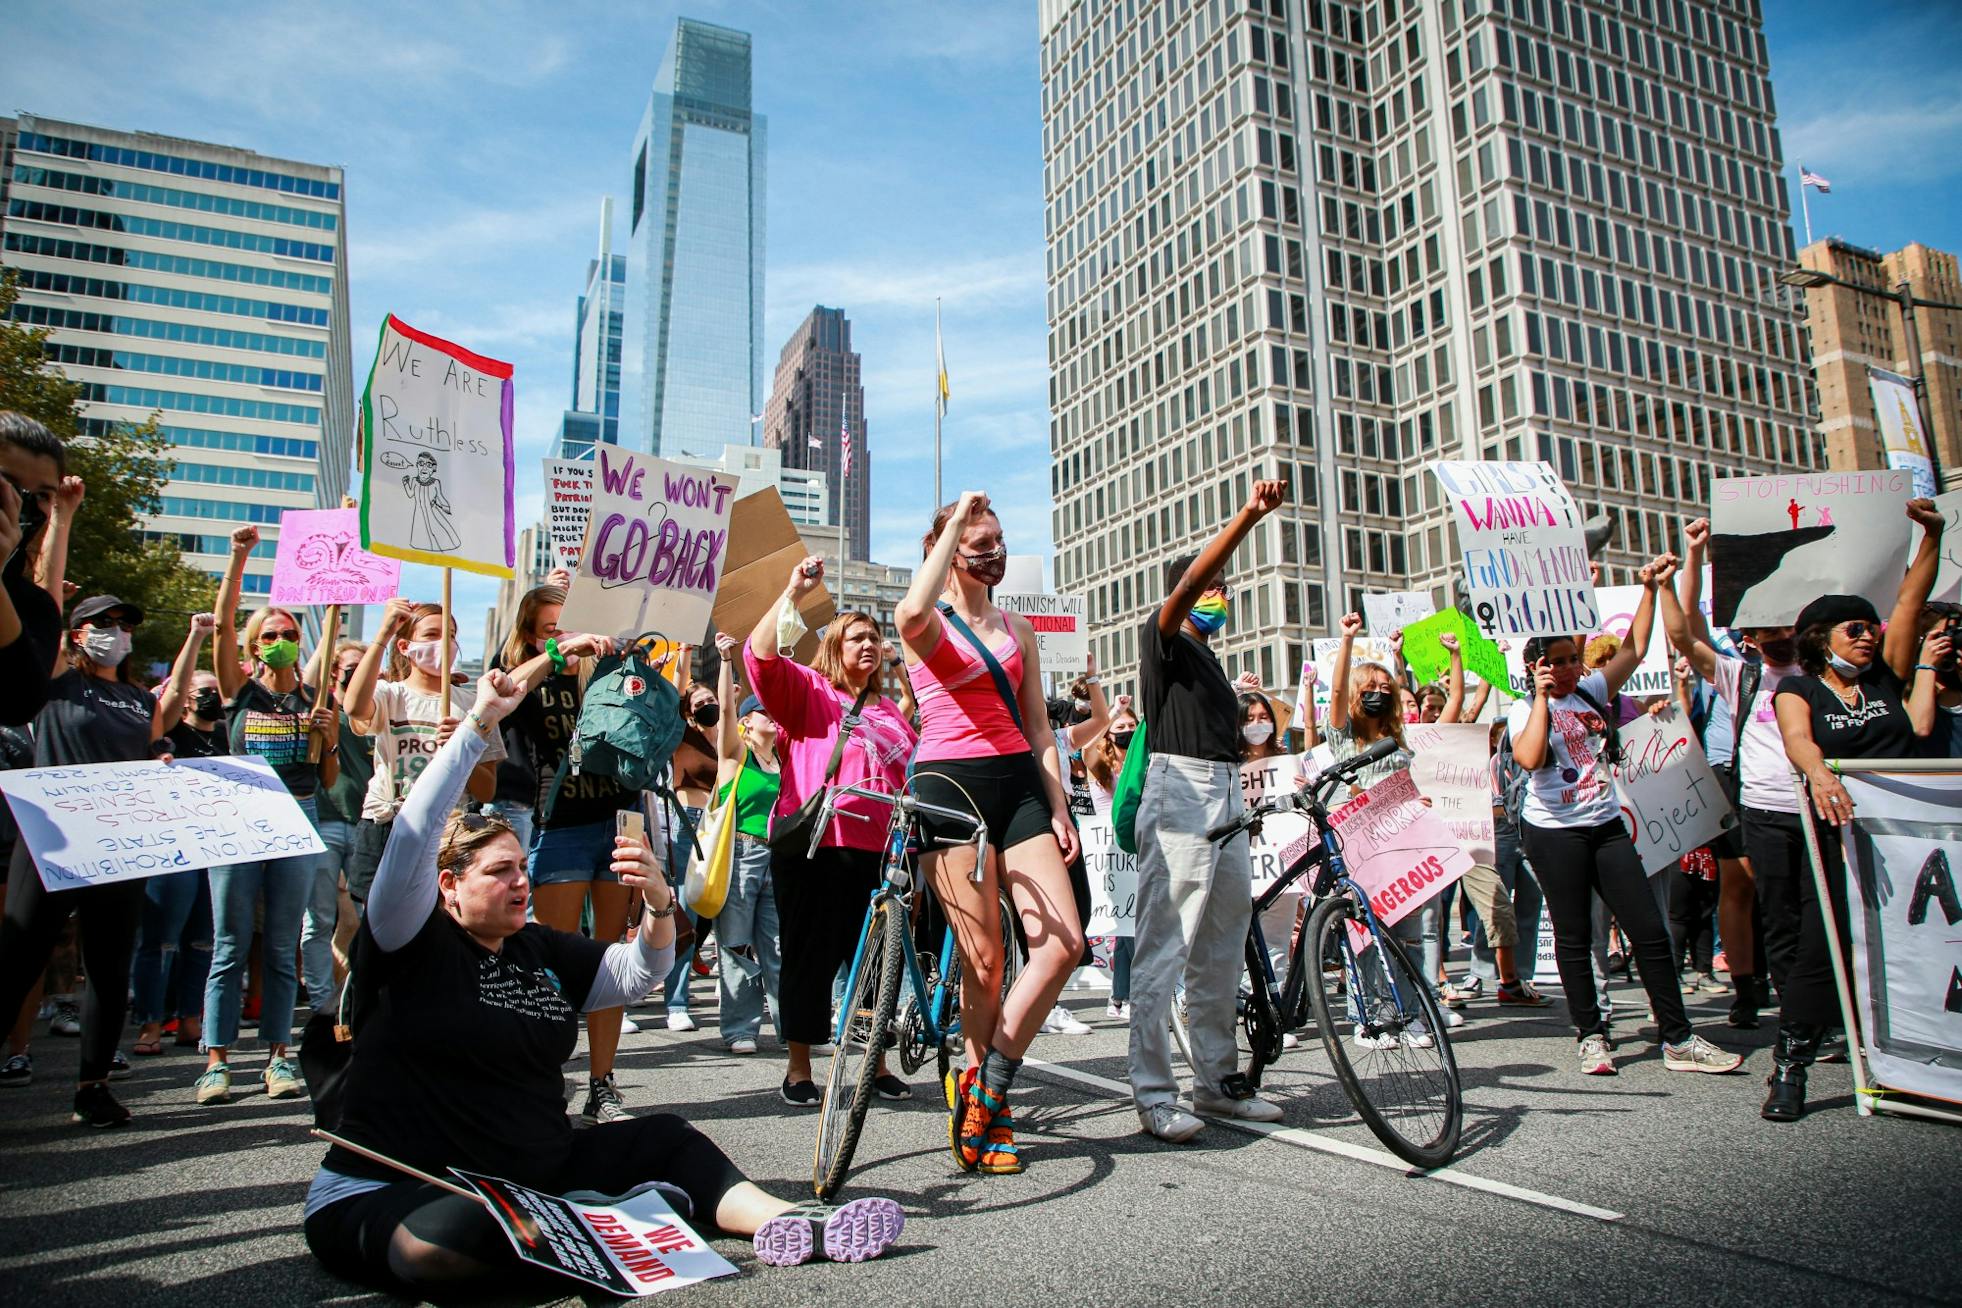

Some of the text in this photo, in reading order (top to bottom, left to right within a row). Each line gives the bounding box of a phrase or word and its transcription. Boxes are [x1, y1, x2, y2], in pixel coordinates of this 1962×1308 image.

[382, 329, 488, 398] WE ARE
[379, 394, 488, 457] Ruthless
[553, 466, 564, 475] IF
[567, 467, 584, 476] YOU
[601, 449, 732, 516] WE WON'T
[1438, 462, 1537, 496] GIRLS
[1718, 480, 1789, 501] STOP
[1796, 474, 1904, 497] PUSHING
[551, 505, 570, 514] BUT
[1461, 496, 1557, 532] WANNA
[560, 546, 583, 556] PAT
[1502, 531, 1532, 545] HAVE
[592, 513, 726, 593] GO BACK
[1464, 545, 1592, 589] FUNDAMENTAL
[998, 595, 1083, 614] FEMINISM WILL
[1494, 587, 1597, 634] RIGHTS
[1643, 671, 1671, 690] ME
[1831, 721, 1845, 730] IS
[398, 738, 438, 755] PRO
[42, 780, 135, 797] EQUALITY
[1436, 761, 1488, 790] BELONG
[54, 790, 155, 812] DENIES
[96, 800, 238, 826] CONTROLS
[1441, 796, 1464, 809] THE
[97, 817, 273, 851] BY THE STATE
[1090, 826, 1115, 846] TH
[1362, 796, 1428, 851] MORE
[45, 832, 313, 882] ABORTION PROHIBITION
[1103, 873, 1116, 892] IS
[1368, 855, 1444, 920] NGEROUS
[1090, 892, 1136, 919] mal
[582, 1212, 677, 1284] DEMAND
[643, 1224, 695, 1255] WE
